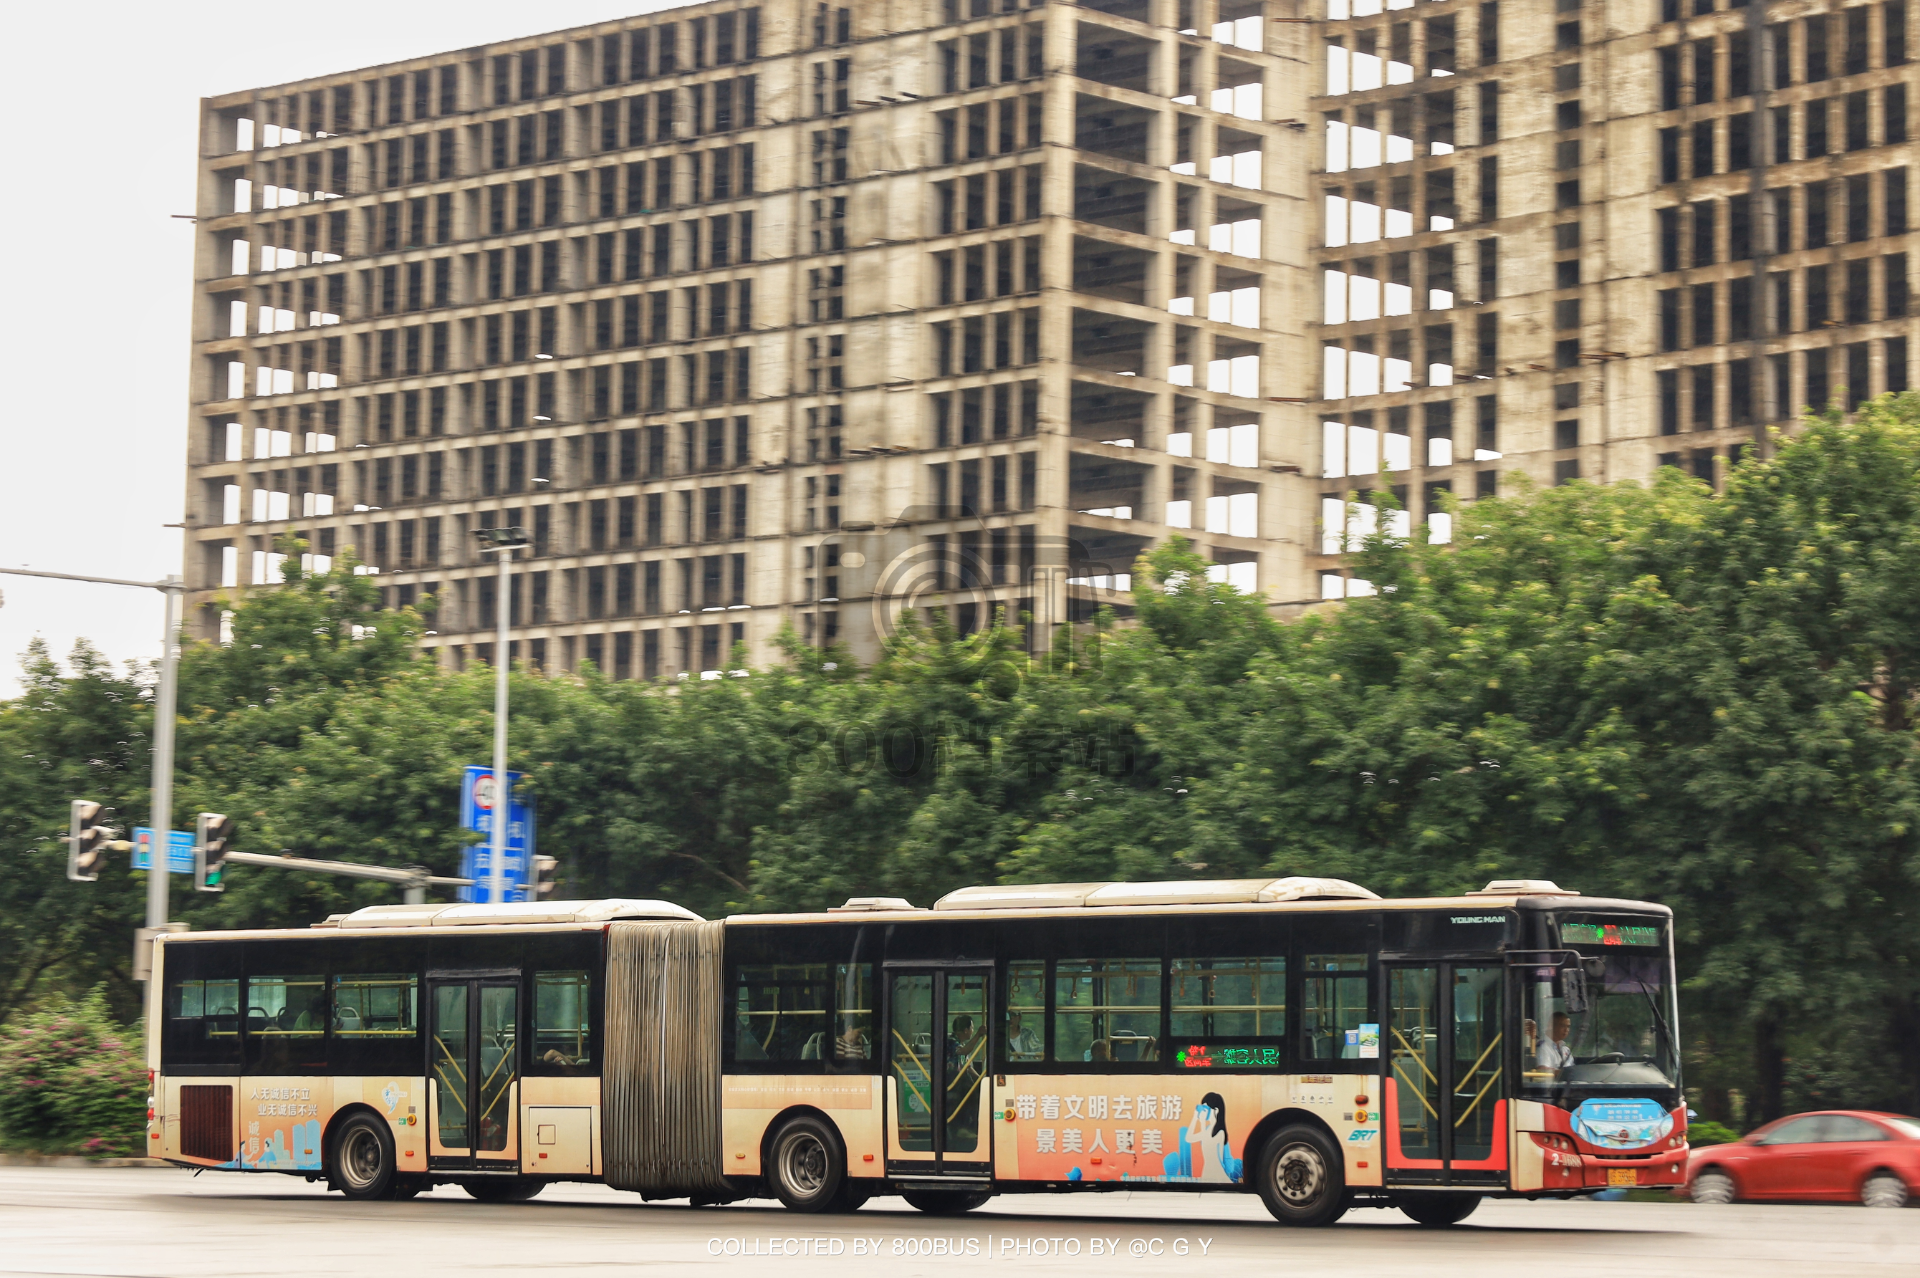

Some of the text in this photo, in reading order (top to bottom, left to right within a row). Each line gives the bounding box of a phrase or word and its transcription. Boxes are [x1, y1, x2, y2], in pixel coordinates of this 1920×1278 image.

[1223, 1048, 1280, 1066] 雒容人民
[250, 1087, 311, 1101] 人无诚信不立
[257, 1103, 318, 1117] 业无诚信不兴
[1016, 1094, 1182, 1121] 带着文明去旅游
[248, 1120, 260, 1154] 诚信
[1036, 1128, 1163, 1155] 景美人更美
[1348, 1129, 1378, 1141] BRT
